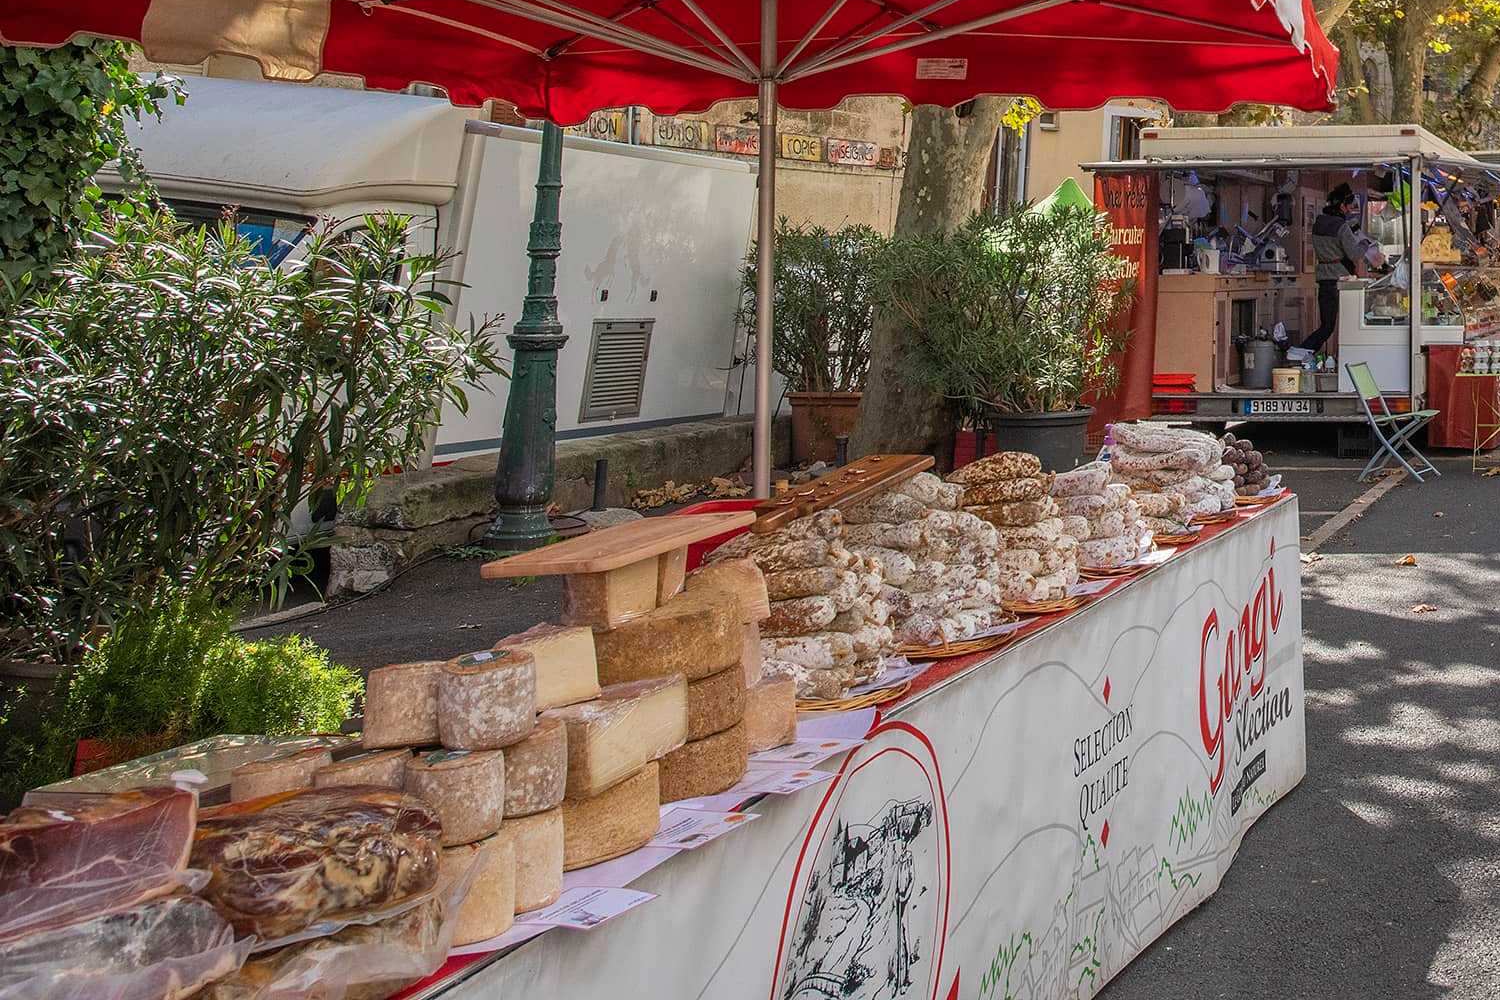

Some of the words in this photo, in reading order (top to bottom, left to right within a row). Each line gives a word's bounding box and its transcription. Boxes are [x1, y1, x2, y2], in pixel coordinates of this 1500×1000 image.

[1253, 401, 1278, 412] 9189
[1281, 401, 1293, 412] YV
[1296, 401, 1308, 412] 34
[1073, 704, 1134, 778] SELECTION
[1079, 755, 1129, 831] QUALITE
